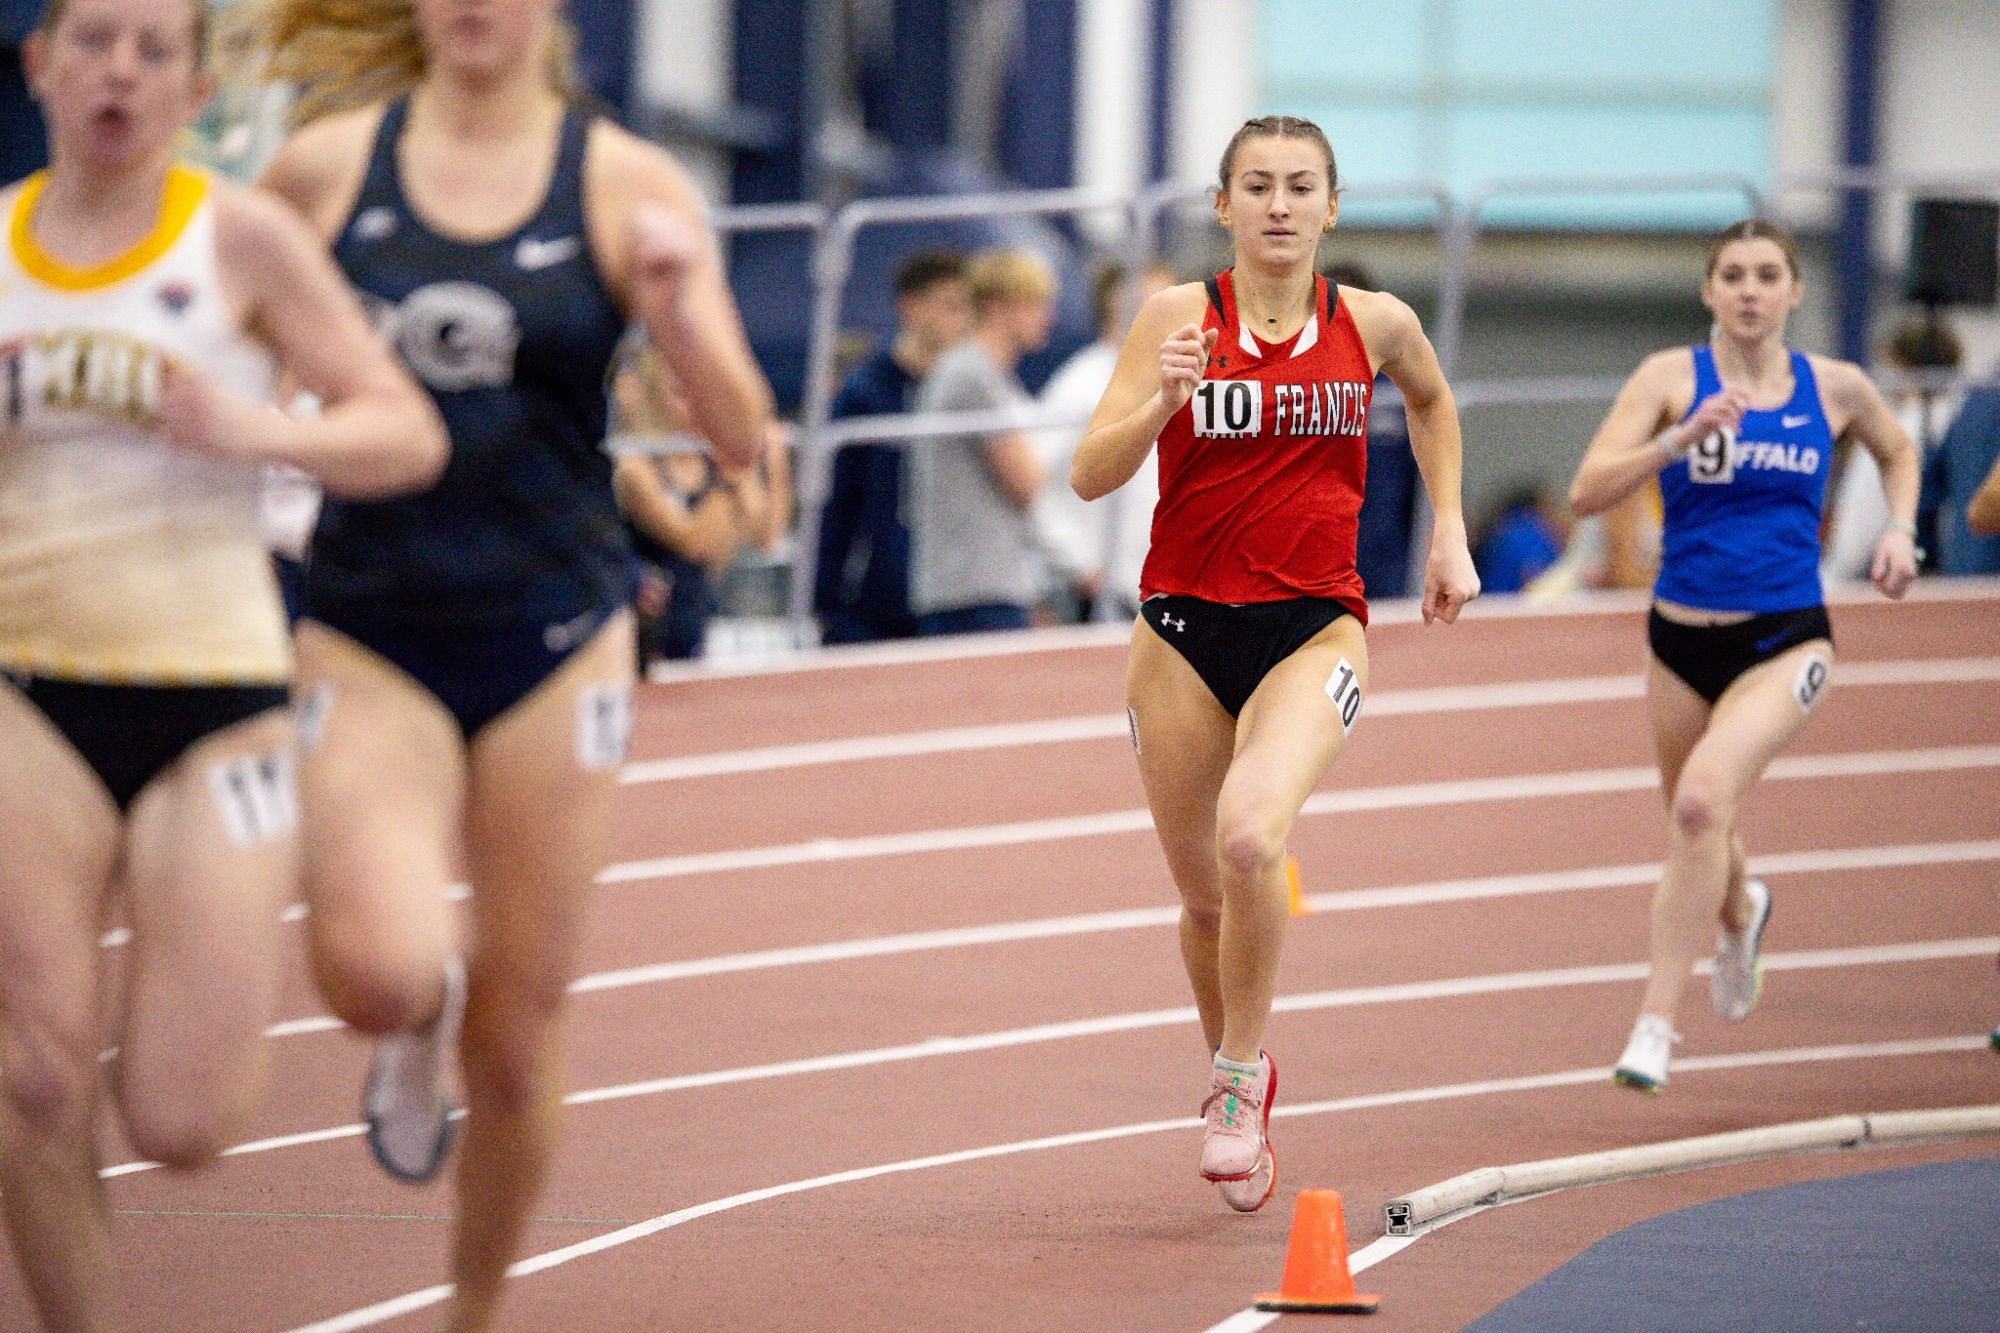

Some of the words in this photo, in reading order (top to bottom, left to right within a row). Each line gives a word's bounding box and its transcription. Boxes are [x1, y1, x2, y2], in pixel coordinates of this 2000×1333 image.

[1197, 382, 1252, 431] 10
[1273, 382, 1367, 437] FRANCIS
[1698, 424, 1726, 476] 9
[1733, 441, 1819, 475] FFALO
[1332, 666, 1360, 728] 10
[1800, 661, 1827, 706] 9
